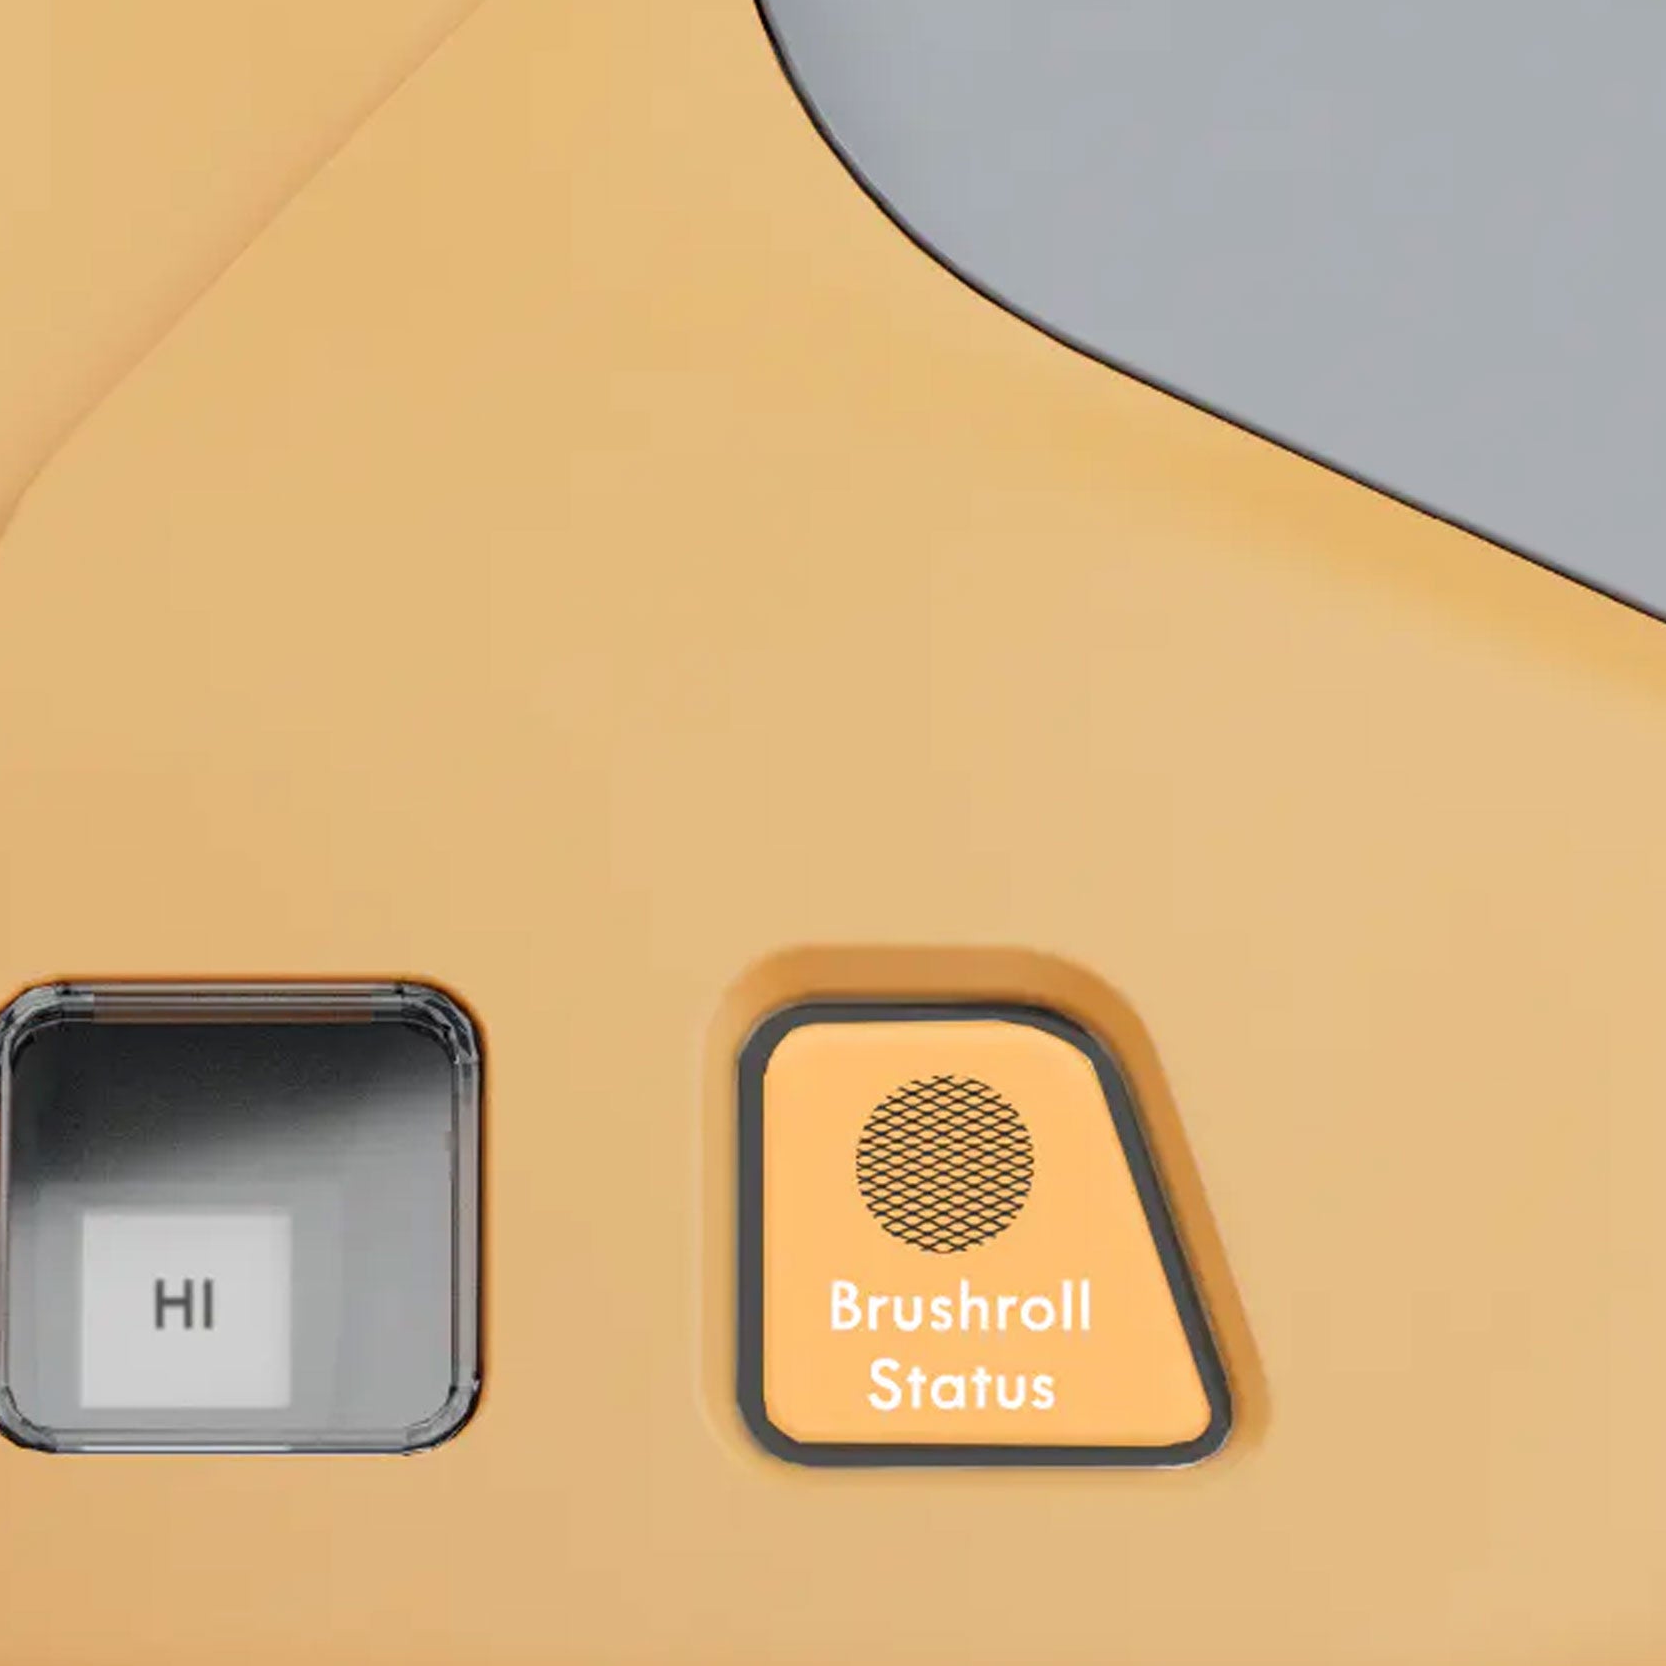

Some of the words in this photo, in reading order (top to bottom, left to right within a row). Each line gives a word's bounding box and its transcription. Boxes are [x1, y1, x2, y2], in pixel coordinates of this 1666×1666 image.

[154, 1278, 215, 1331] HI
[829, 1279, 1092, 1332] Brushroll
[866, 1357, 1057, 1412] Status
